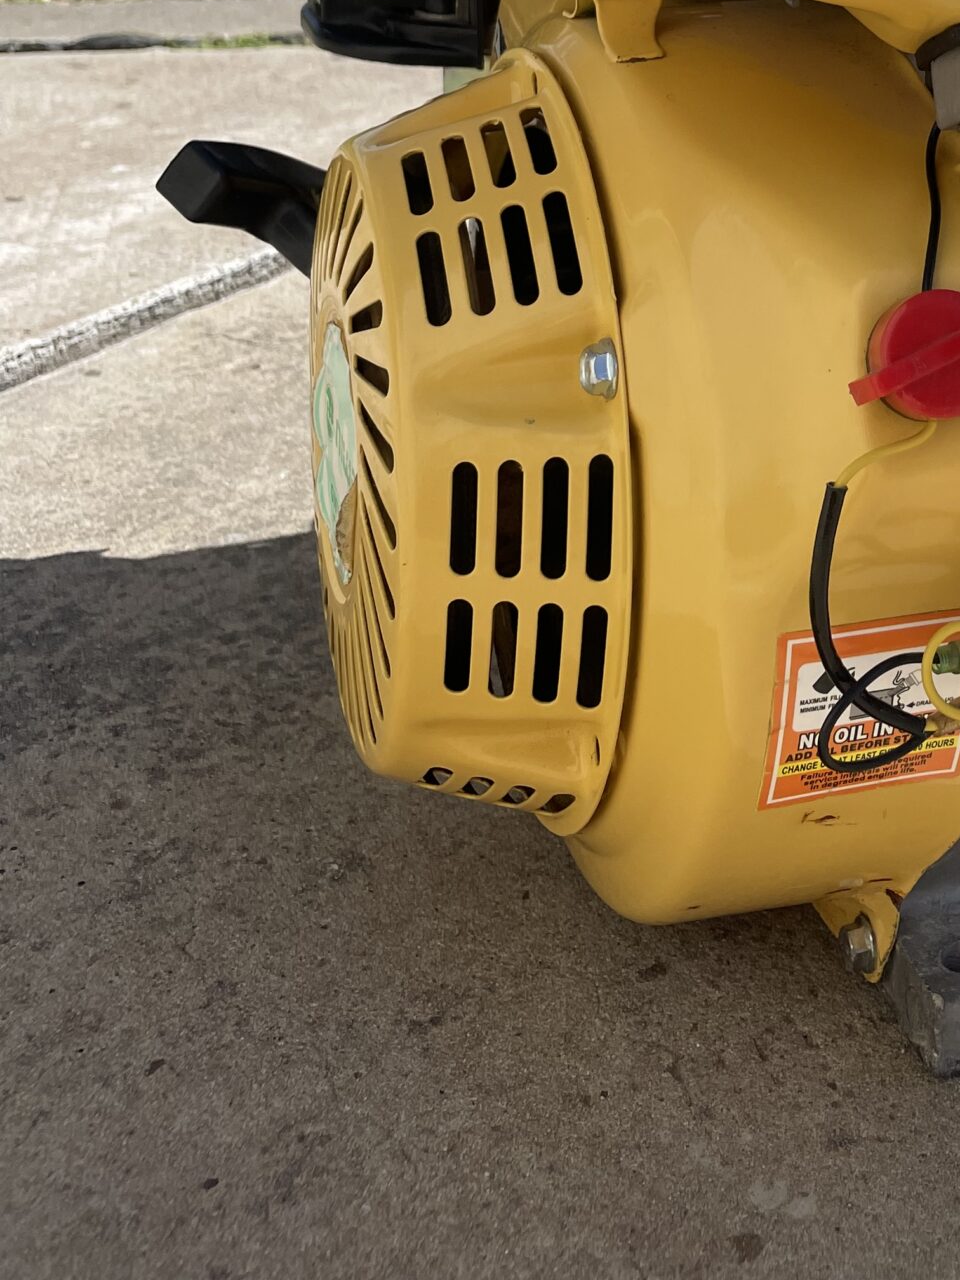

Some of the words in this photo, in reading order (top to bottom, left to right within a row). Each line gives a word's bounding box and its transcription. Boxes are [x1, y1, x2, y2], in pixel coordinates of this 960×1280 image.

[833, 724, 868, 744] OIL
[872, 722, 894, 738] IN
[782, 761, 818, 775] CHANGE
[925, 738, 954, 749] HOURS
[786, 751, 812, 763] ADD
[841, 738, 890, 753] BEFORE
[801, 771, 833, 781] Failure
[804, 776, 838, 786] service
[822, 776, 865, 788] degraded
